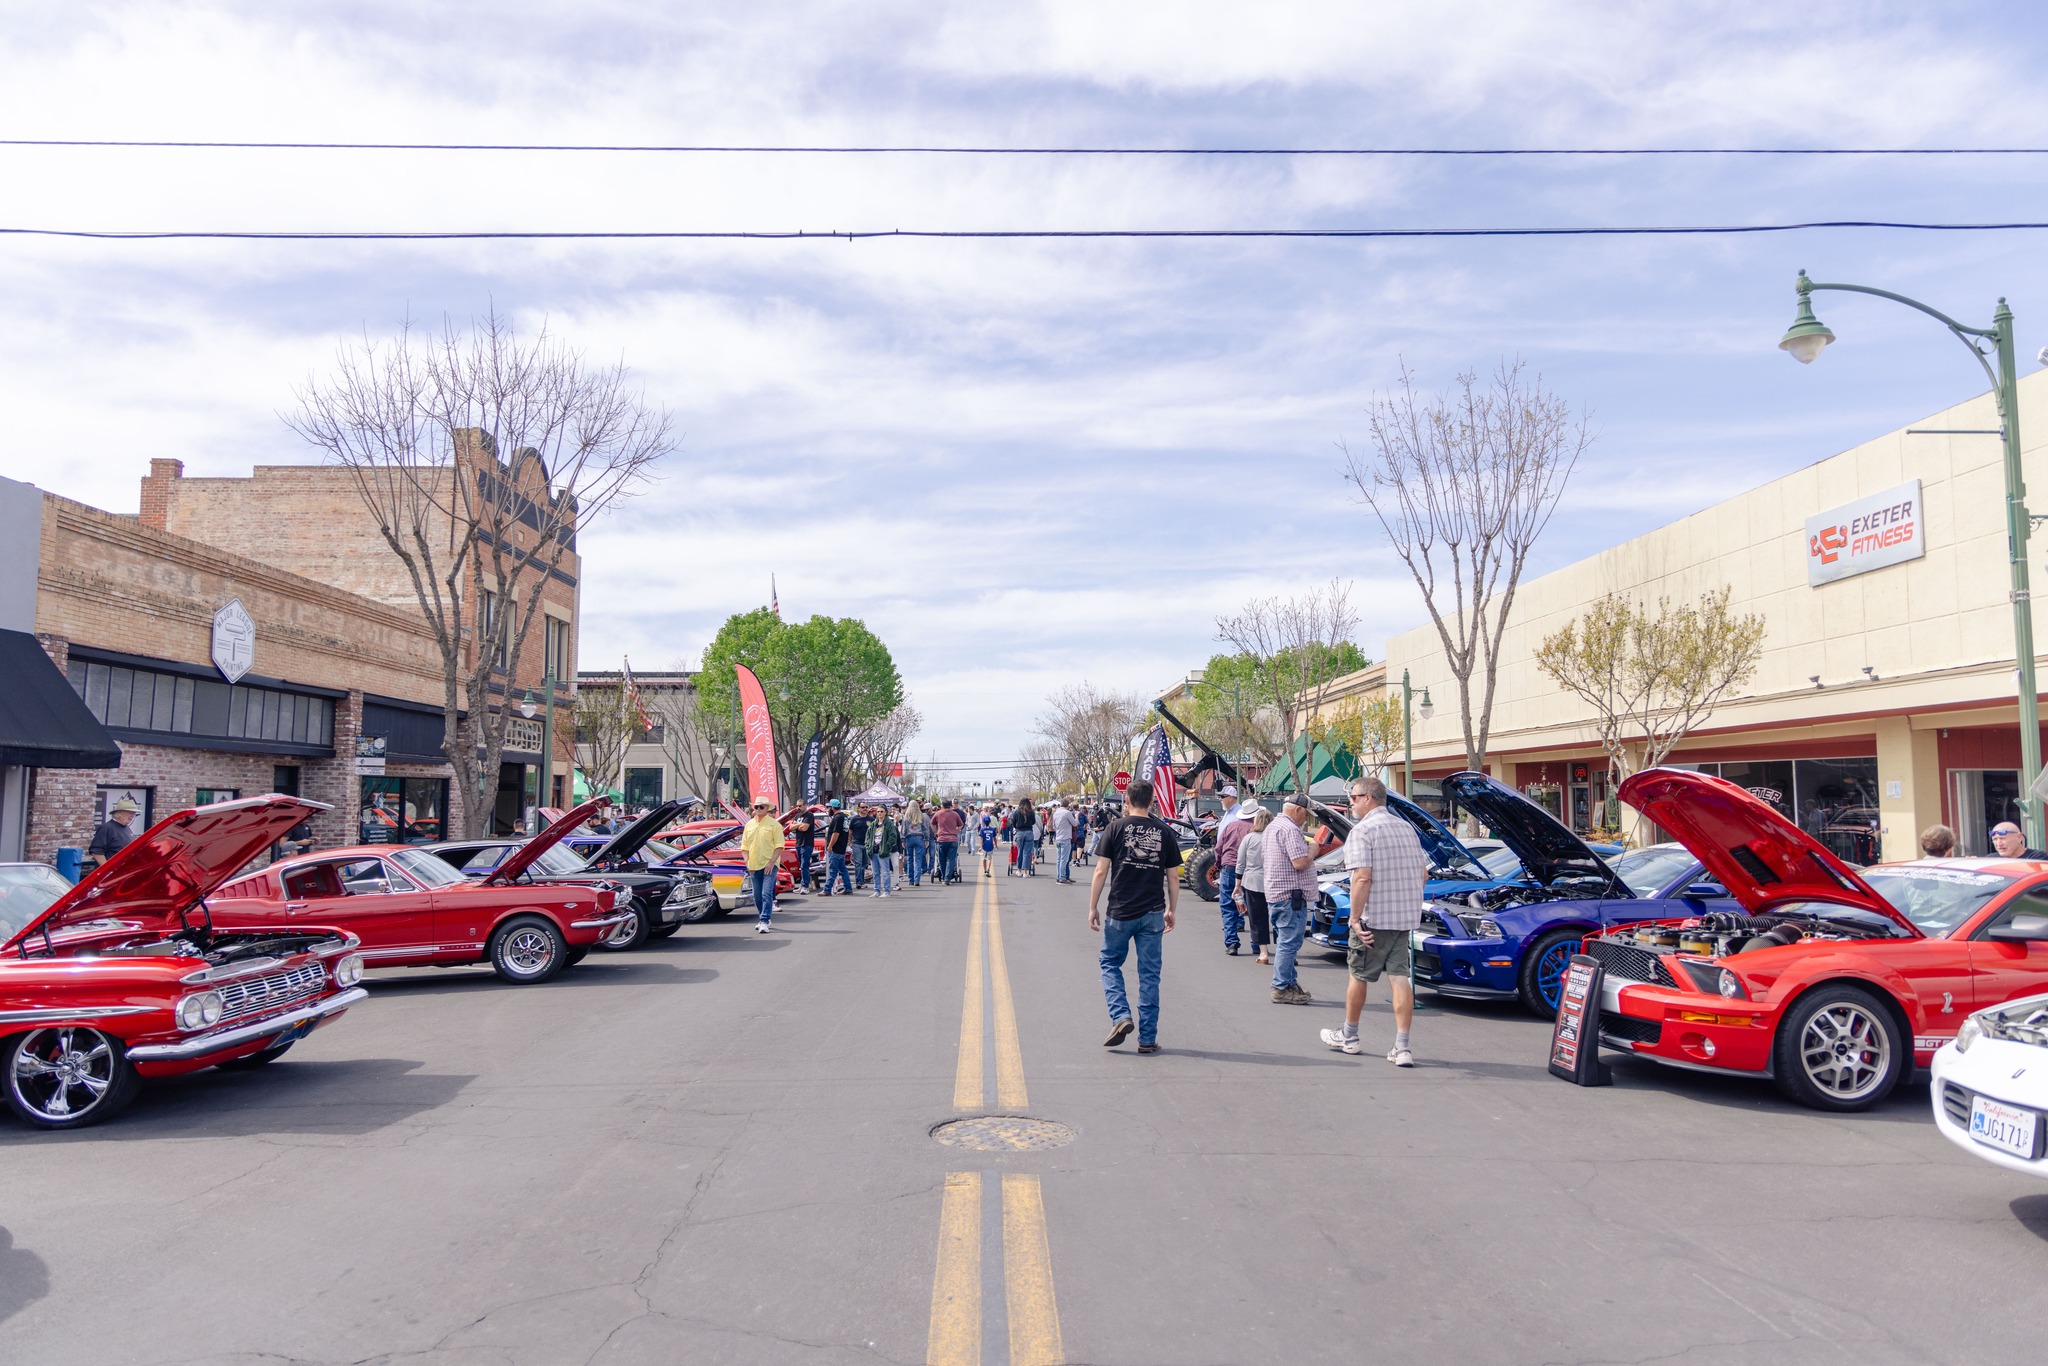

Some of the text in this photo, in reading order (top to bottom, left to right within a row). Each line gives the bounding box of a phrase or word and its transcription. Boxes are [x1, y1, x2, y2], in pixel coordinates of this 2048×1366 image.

[1851, 501, 1912, 535] EXETER
[1852, 522, 1914, 557] FITNESS
[216, 608, 253, 635] MAJOR LEAGUE
[222, 658, 244, 673] PAINTING
[807, 741, 819, 796] PHAROAHS
[1141, 740, 1156, 780] PHARO
[1114, 777, 1131, 785] STOP
[1746, 787, 1782, 803] ETER
[985, 833, 991, 841] 5
[1985, 1103, 2019, 1120] California
[1984, 1118, 2021, 1148] JG171
